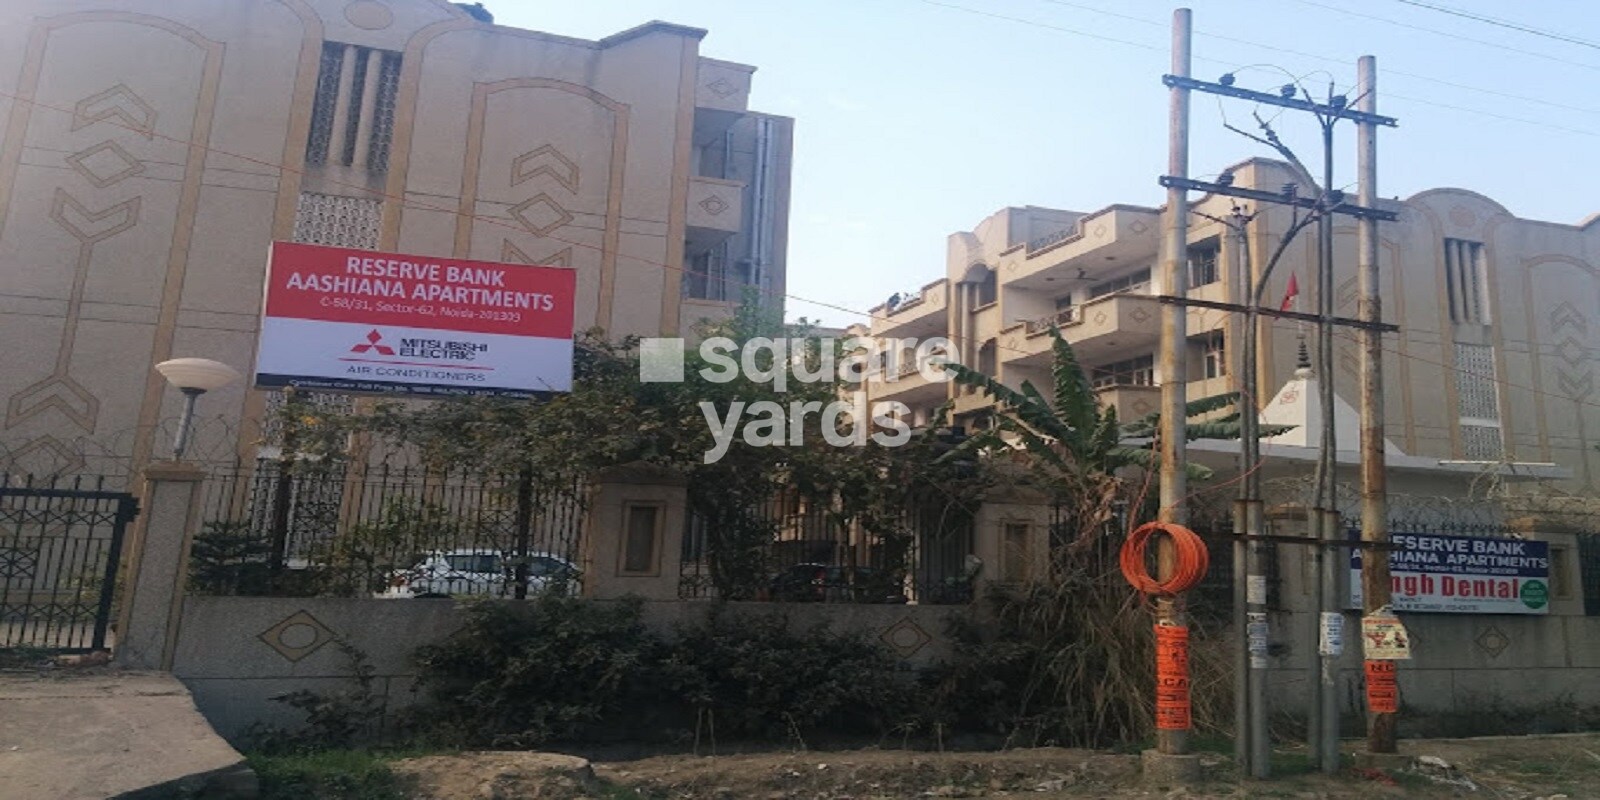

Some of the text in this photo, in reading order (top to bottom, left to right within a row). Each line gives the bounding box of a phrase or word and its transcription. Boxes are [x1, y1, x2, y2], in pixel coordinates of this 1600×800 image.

[347, 256, 506, 287] RESERVE BANK
[286, 272, 554, 312] AASHIANA APARTMENTS
[400, 338, 488, 352] MITSUBISHI
[400, 347, 476, 361] ELECTRIC
[346, 365, 486, 382] AIR CONDITIONERS
[1390, 535, 1526, 555] ESERVE BANK
[1447, 553, 1548, 568] APARTMENTS
[1441, 575, 1519, 599] Dental
